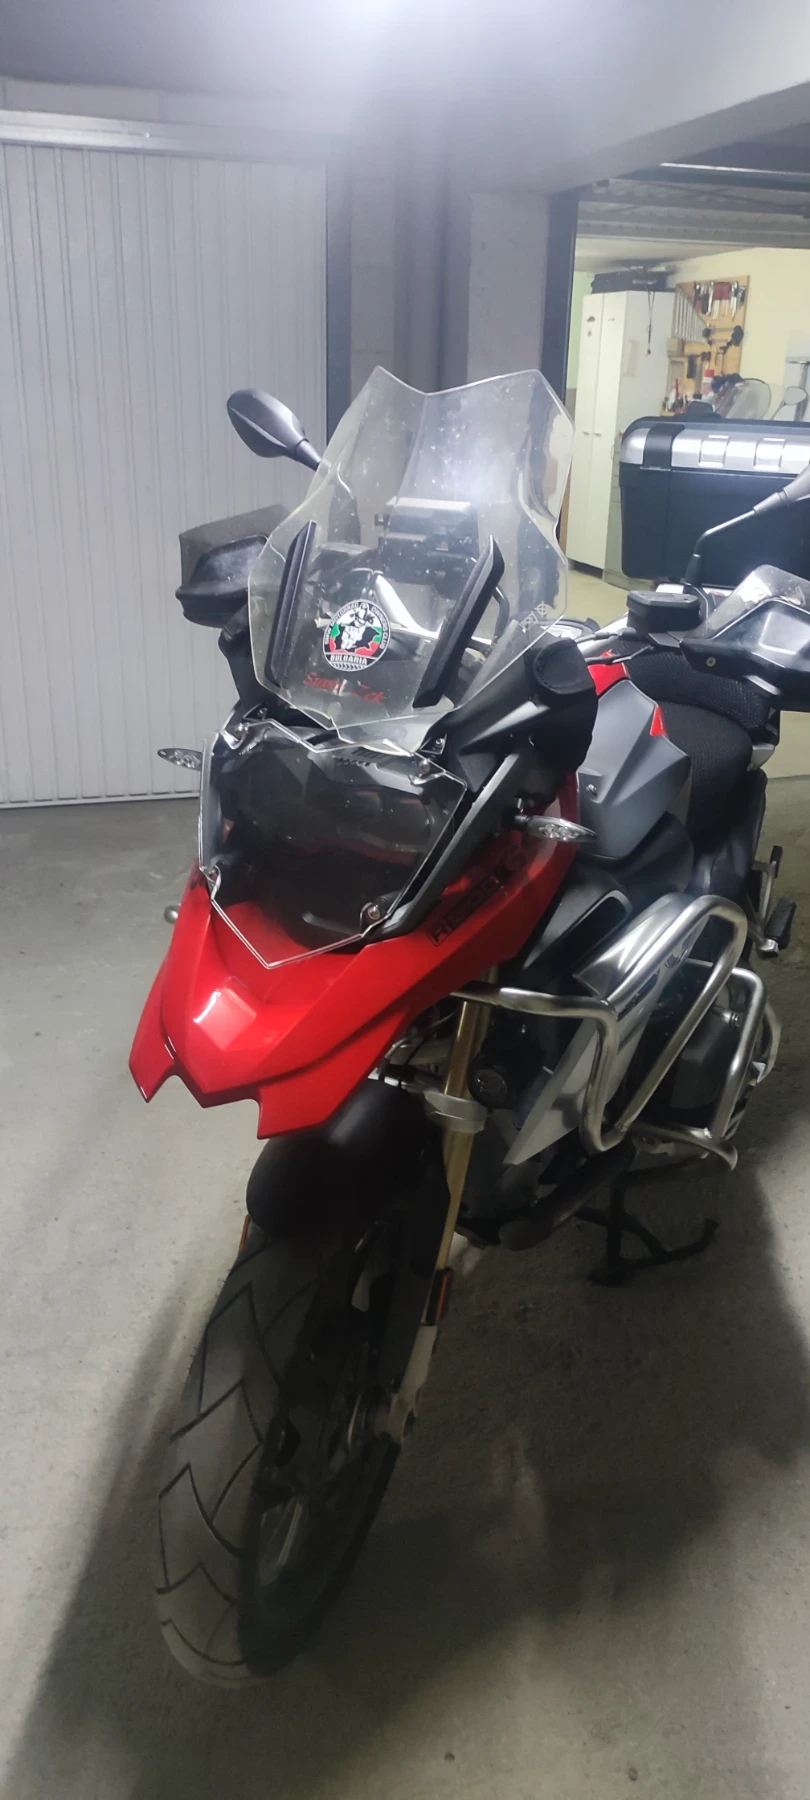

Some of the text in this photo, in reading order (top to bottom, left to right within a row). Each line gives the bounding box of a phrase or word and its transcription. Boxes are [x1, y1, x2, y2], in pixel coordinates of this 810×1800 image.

[371, 607, 388, 631] OWNERS
[379, 632, 388, 649] CLUB
[330, 654, 367, 665] BULGARIA
